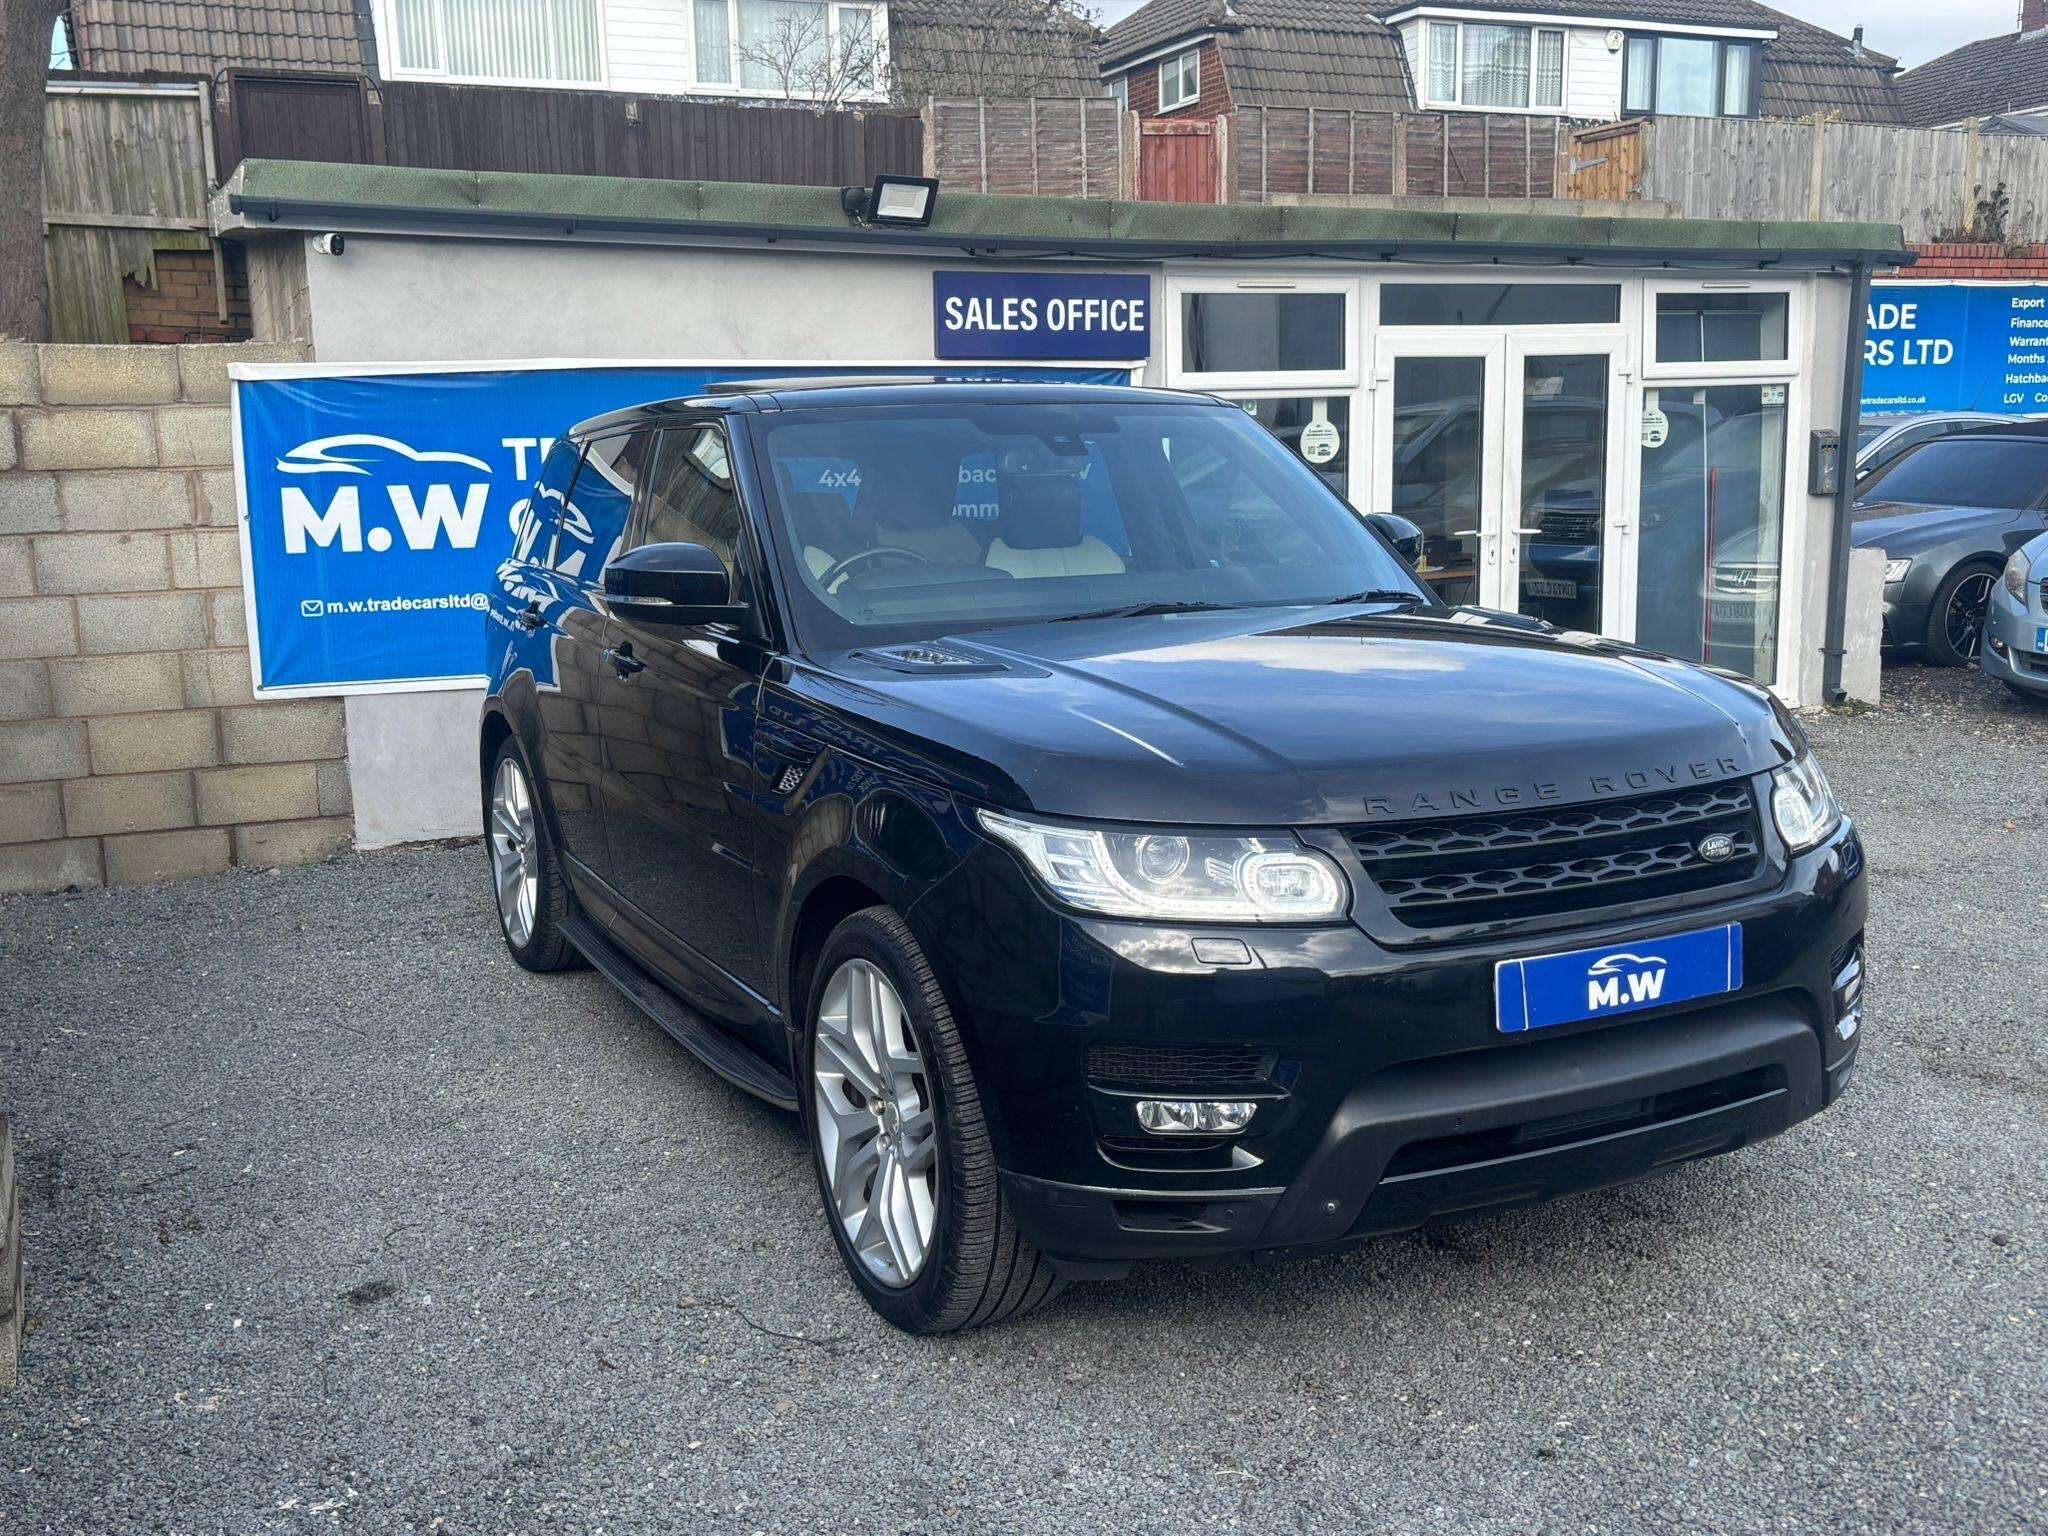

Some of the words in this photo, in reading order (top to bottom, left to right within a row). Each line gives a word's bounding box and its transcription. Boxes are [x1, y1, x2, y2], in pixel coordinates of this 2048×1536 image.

[2010, 297, 2045, 310] Export
[945, 297, 1038, 331] SALES
[1046, 299, 1145, 332] OFFICE
[2010, 317, 2048, 329] Finance
[1903, 339, 1954, 365] LTD
[2007, 353, 2046, 364] Months
[2003, 393, 2025, 404] LGV
[818, 468, 862, 488] 4x4
[280, 483, 490, 554] M.W
[327, 593, 490, 614] m.w.tradecarsltd@
[1364, 782, 1560, 816] RANGE
[1589, 757, 1741, 794] ROVER
[1588, 966, 1667, 1010] M.W
